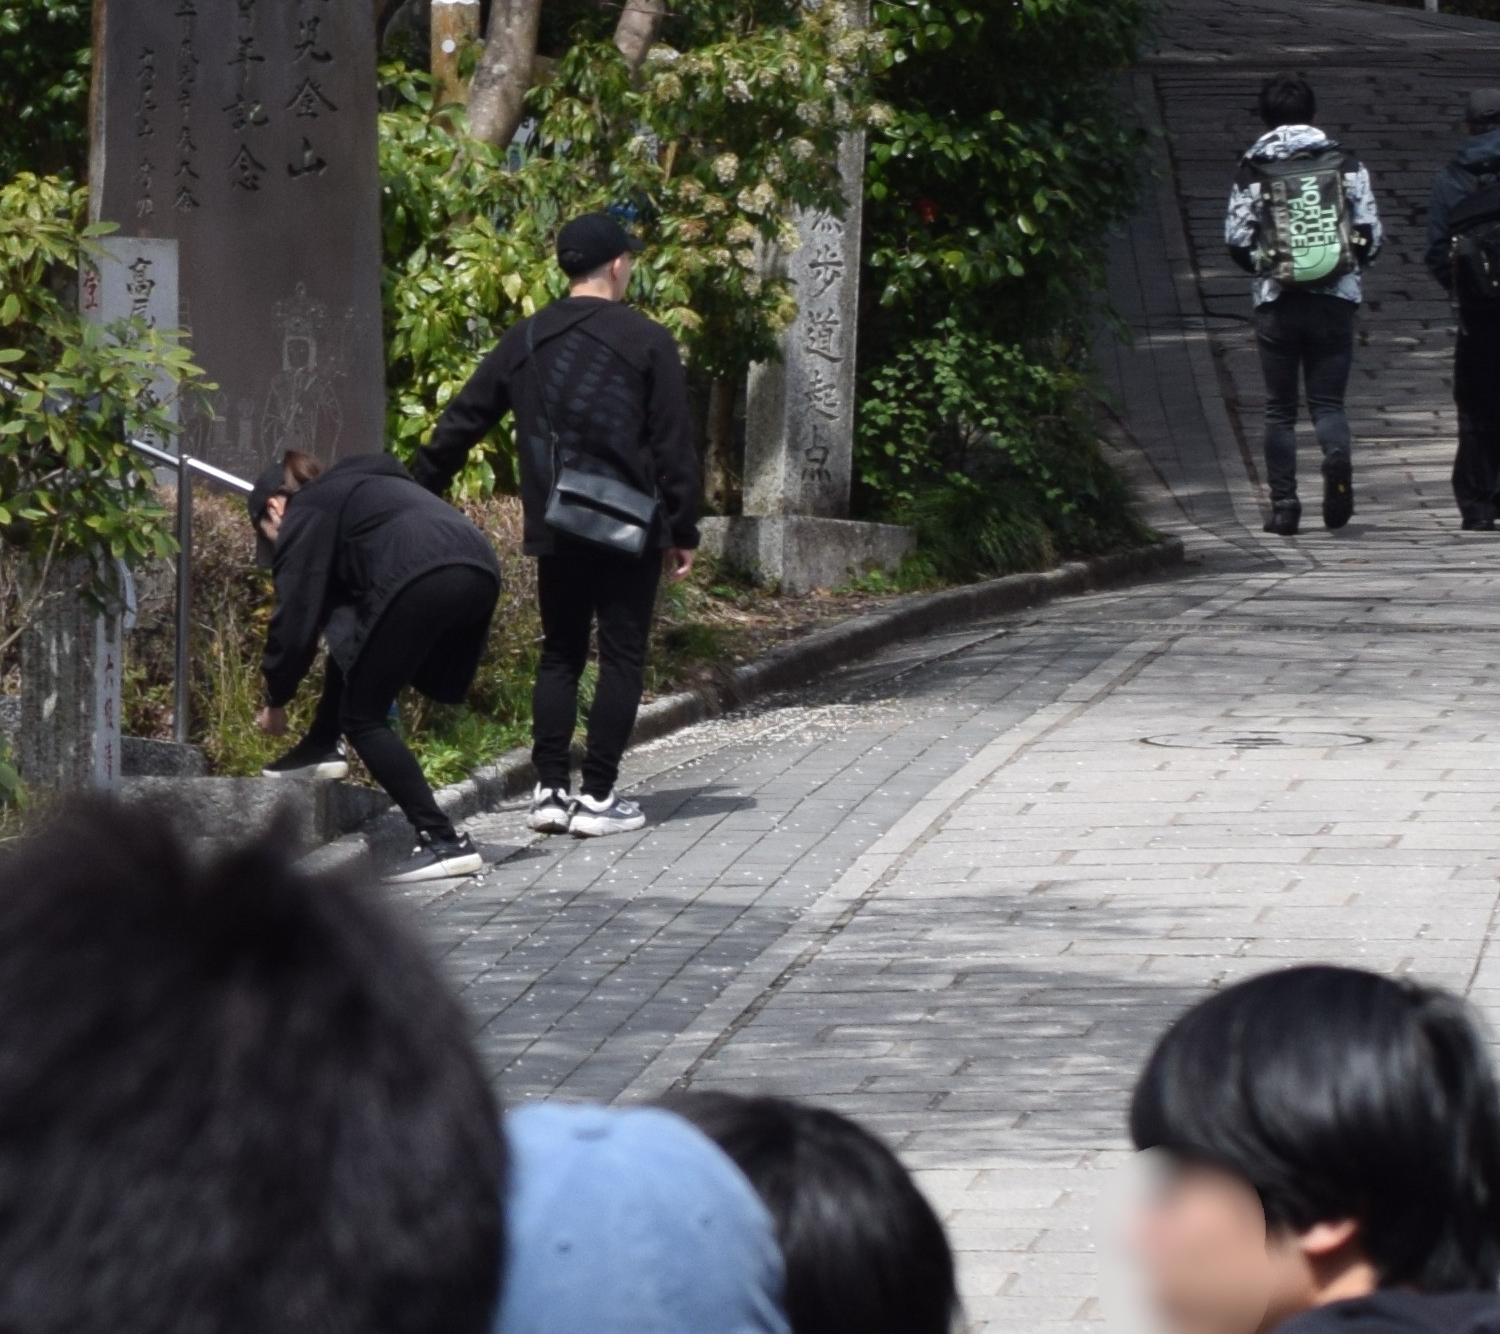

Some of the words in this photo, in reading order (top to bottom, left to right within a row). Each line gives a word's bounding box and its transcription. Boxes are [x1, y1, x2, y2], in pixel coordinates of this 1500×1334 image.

[1288, 197, 1308, 247] FACE
[1300, 176, 1324, 246] NORTH
[1320, 205, 1340, 246] THE
